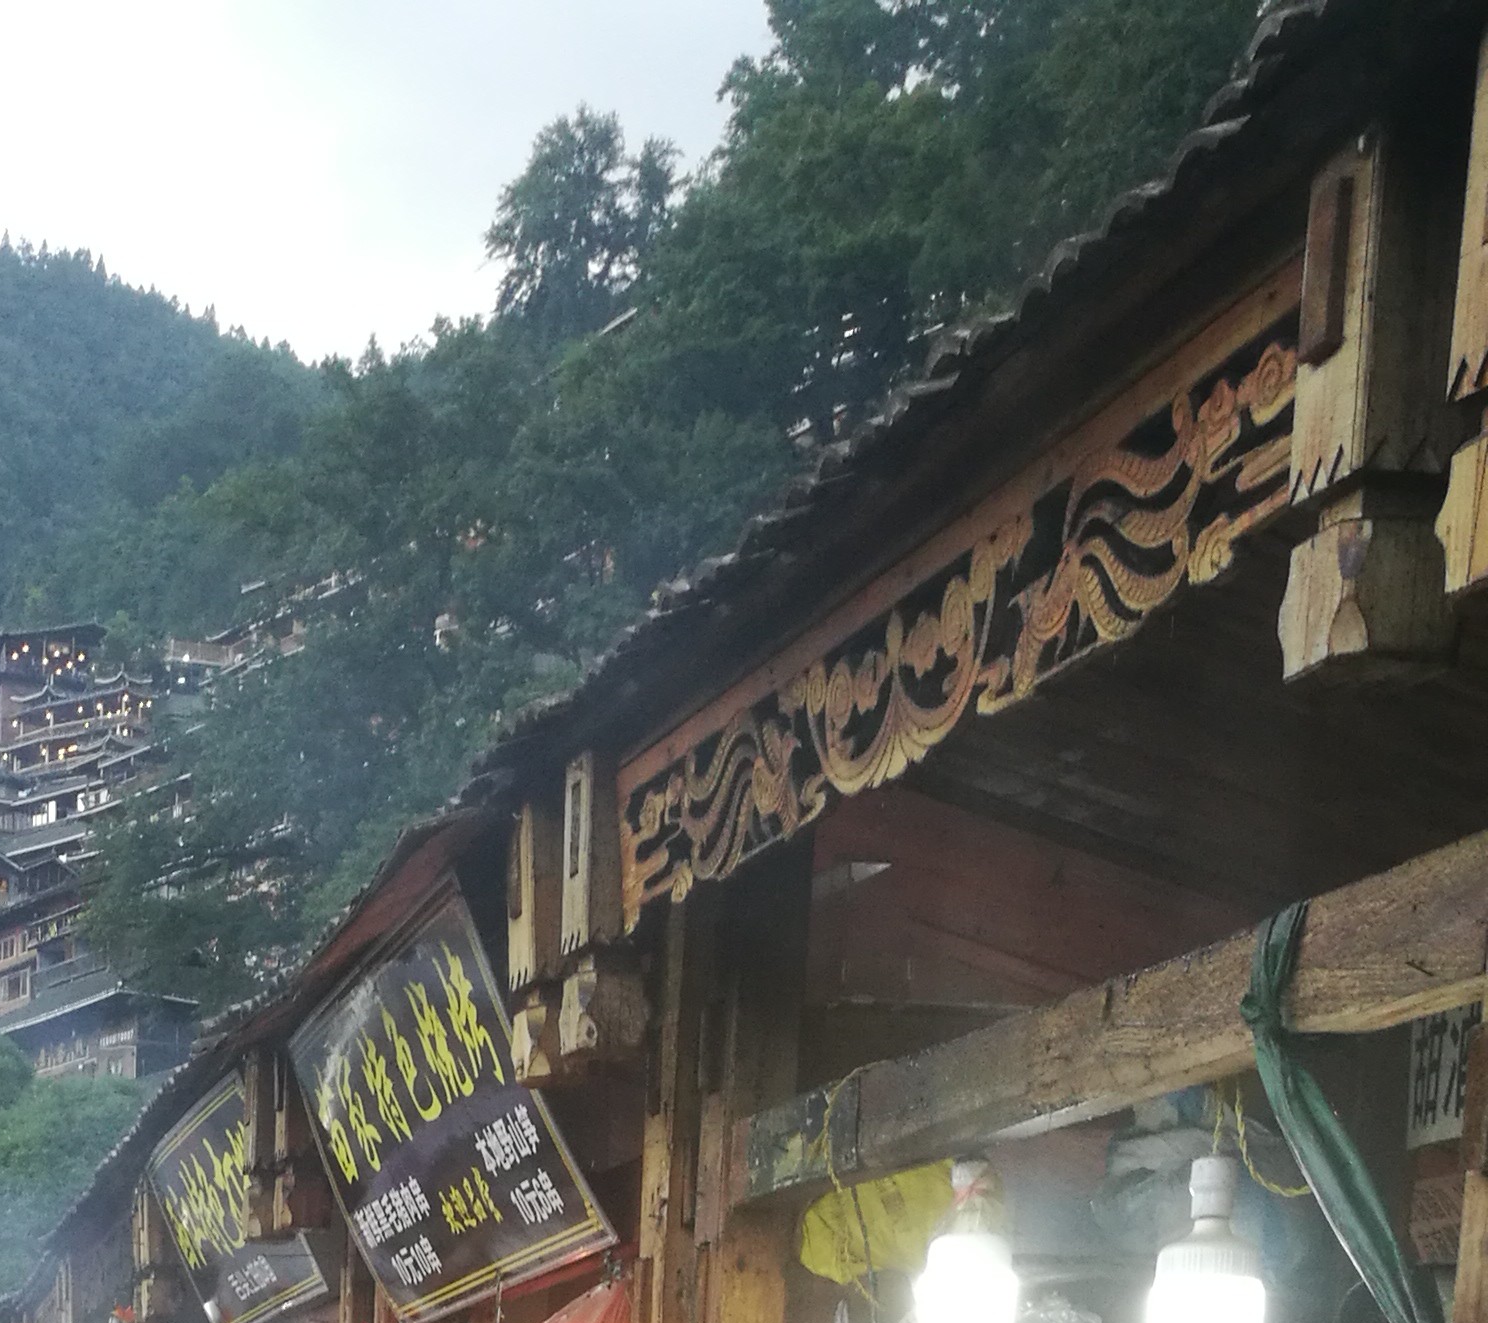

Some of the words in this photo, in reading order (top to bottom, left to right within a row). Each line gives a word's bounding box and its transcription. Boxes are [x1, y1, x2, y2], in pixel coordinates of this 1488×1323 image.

[313, 939, 505, 1185] 苗家特色烧烤
[474, 1103, 540, 1178] 本地野山笋
[510, 1167, 565, 1226] 10元6串
[391, 1234, 443, 1287] 10元10串
